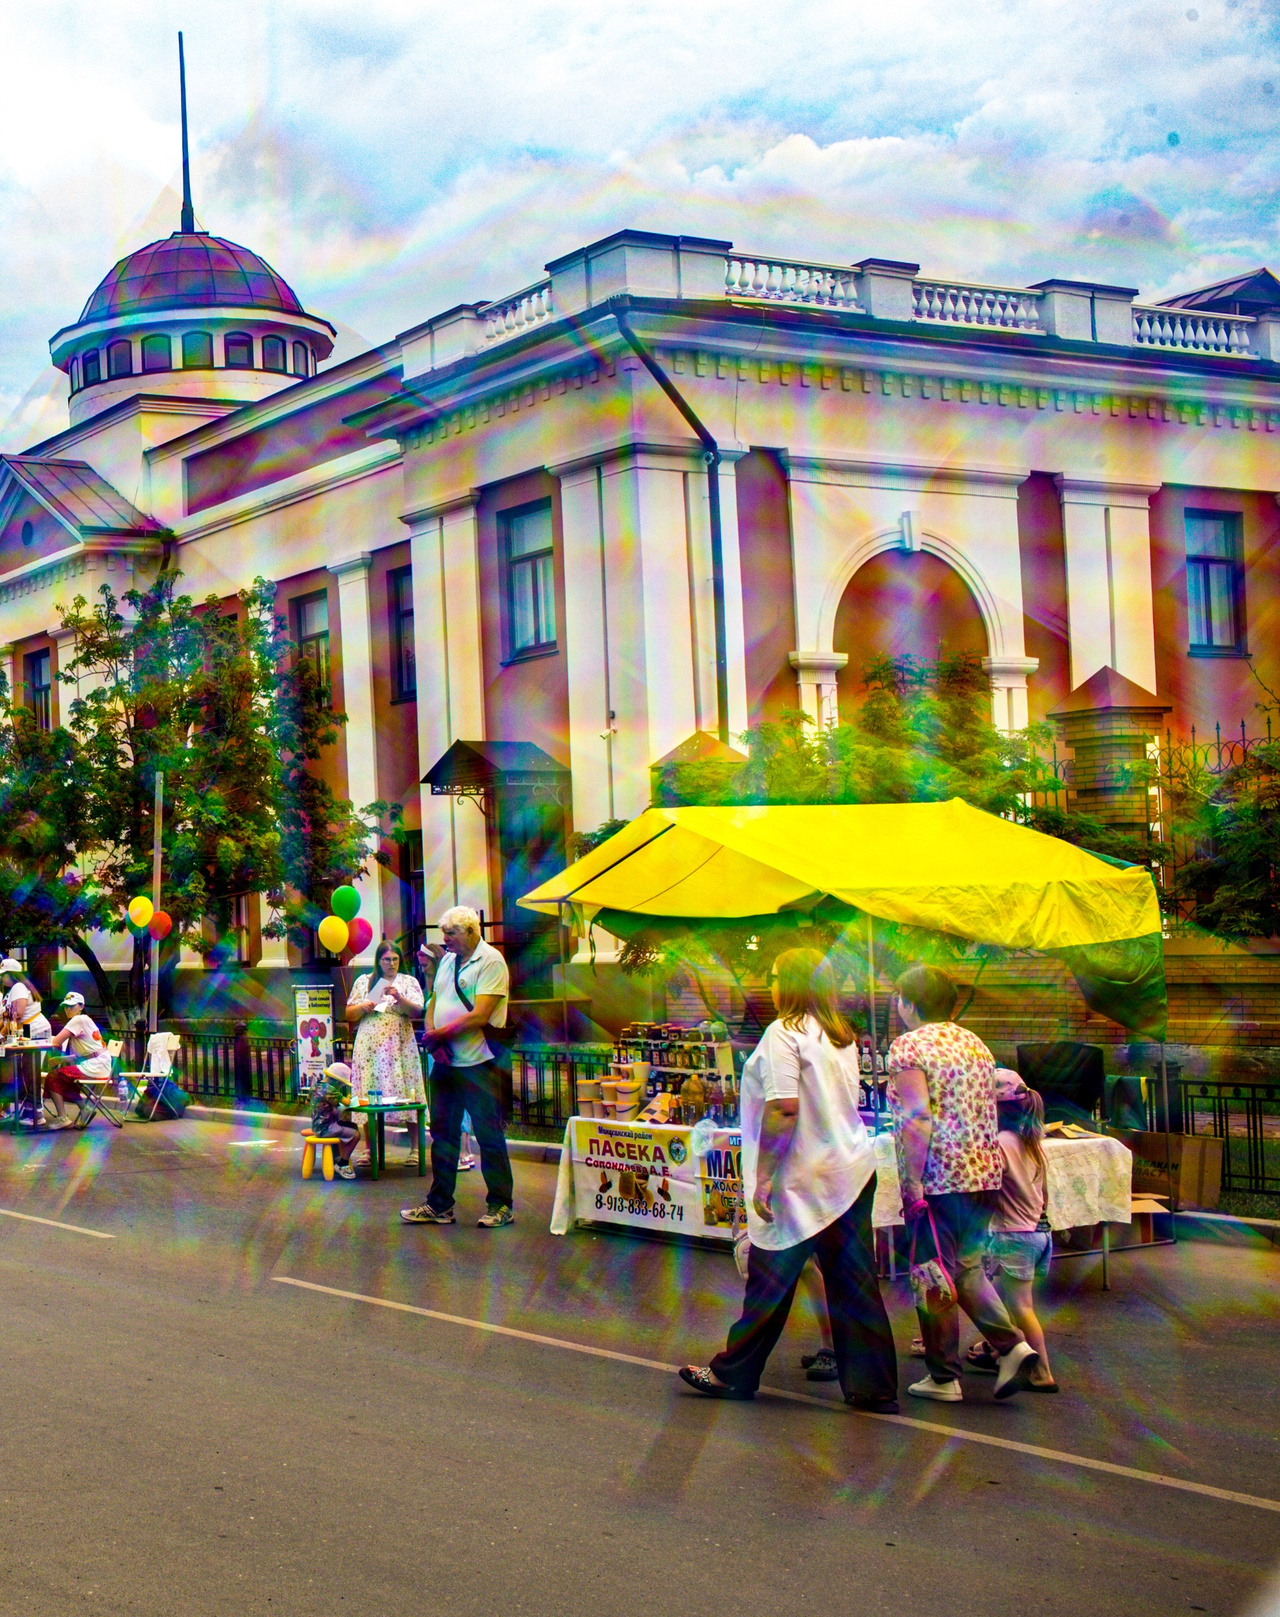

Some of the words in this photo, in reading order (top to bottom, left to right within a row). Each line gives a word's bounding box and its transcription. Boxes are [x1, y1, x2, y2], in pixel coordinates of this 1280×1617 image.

[634, 1131, 653, 1141] район
[588, 1138, 666, 1164] ПАСЕКА
[595, 1192, 684, 1222] 8-913-833-68-74
